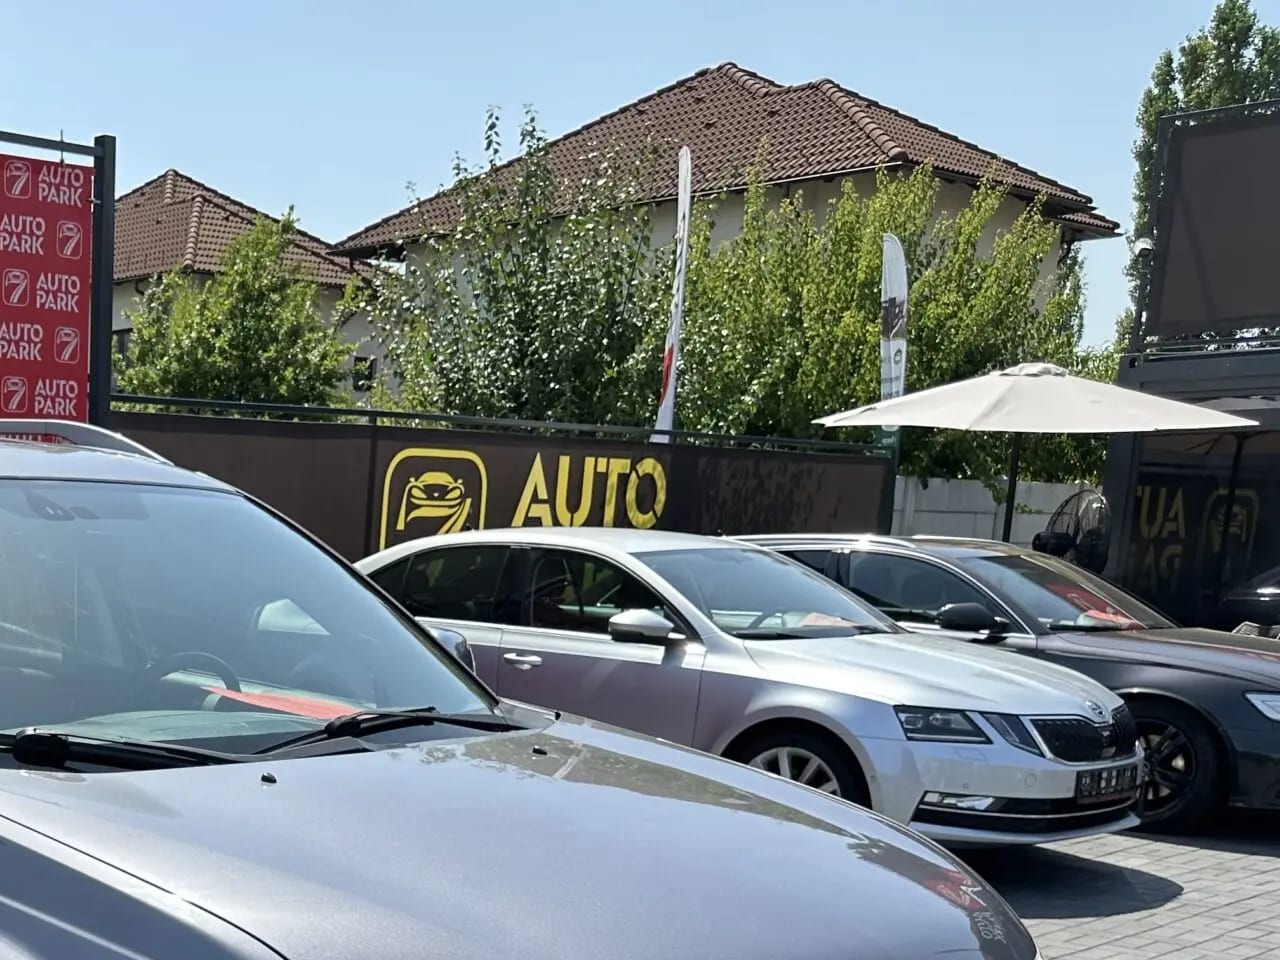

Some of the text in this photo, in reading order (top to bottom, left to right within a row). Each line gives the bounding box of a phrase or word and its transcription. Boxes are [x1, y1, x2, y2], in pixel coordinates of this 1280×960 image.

[38, 165, 83, 187] AUTO
[39, 183, 82, 207] PARK
[0, 214, 45, 235] AUTO
[0, 232, 44, 255] PARK
[36, 272, 80, 294] AUTO
[36, 290, 79, 313] PARK
[35, 379, 78, 398] AUTO
[35, 396, 76, 416] PARK
[510, 451, 667, 529] AUTO
